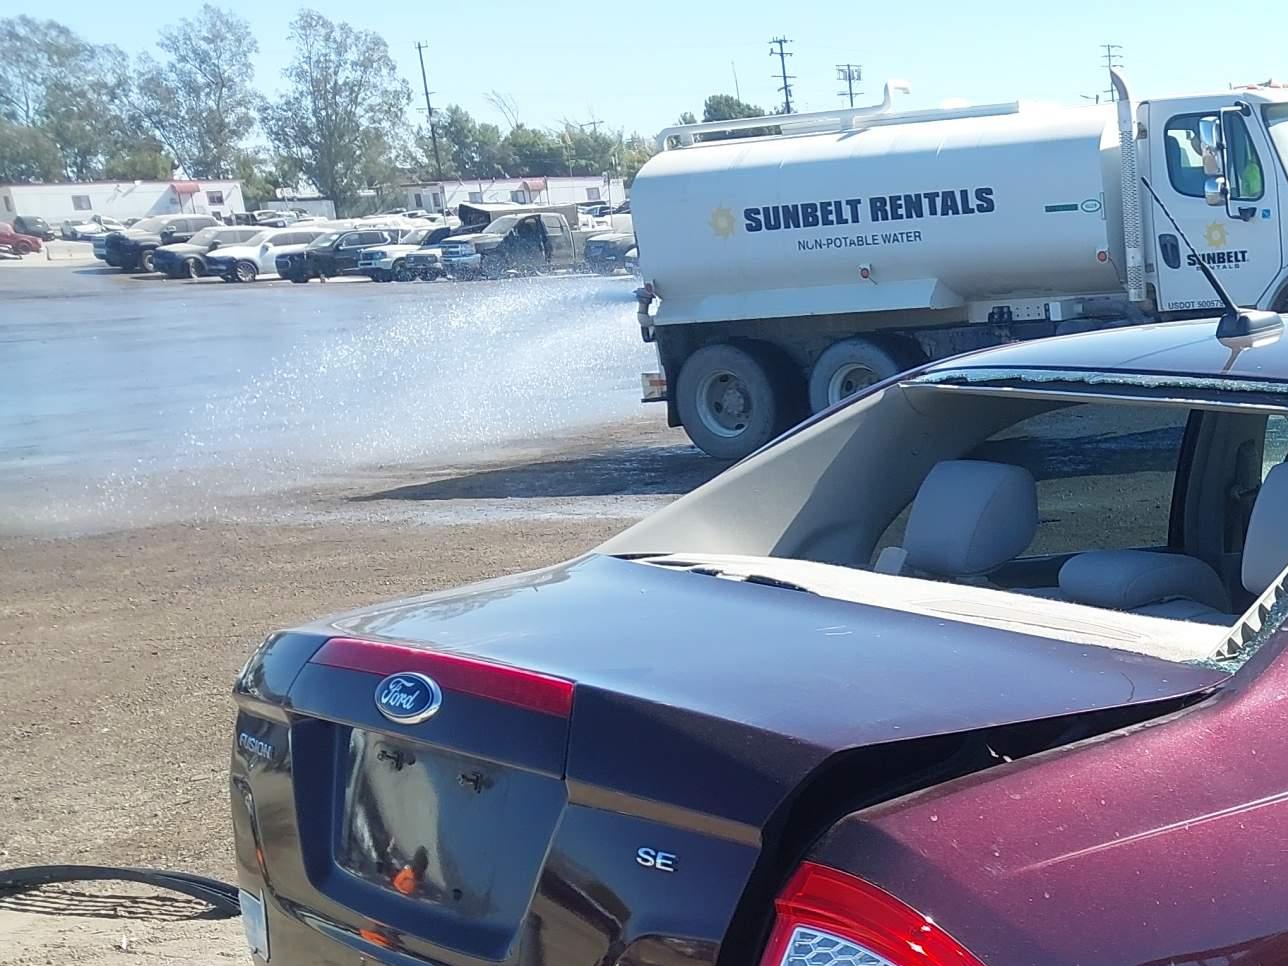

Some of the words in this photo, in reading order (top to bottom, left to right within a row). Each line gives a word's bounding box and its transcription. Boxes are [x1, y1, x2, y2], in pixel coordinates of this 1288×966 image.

[744, 199, 861, 232] SUNBELT
[869, 187, 995, 223] RENTALS
[797, 234, 879, 251] NON-POTABLE
[882, 230, 922, 244] WATER
[1168, 301, 1195, 310] USDOT
[381, 678, 421, 710] Ford
[239, 732, 272, 760] FUSION
[636, 847, 676, 872] SE
